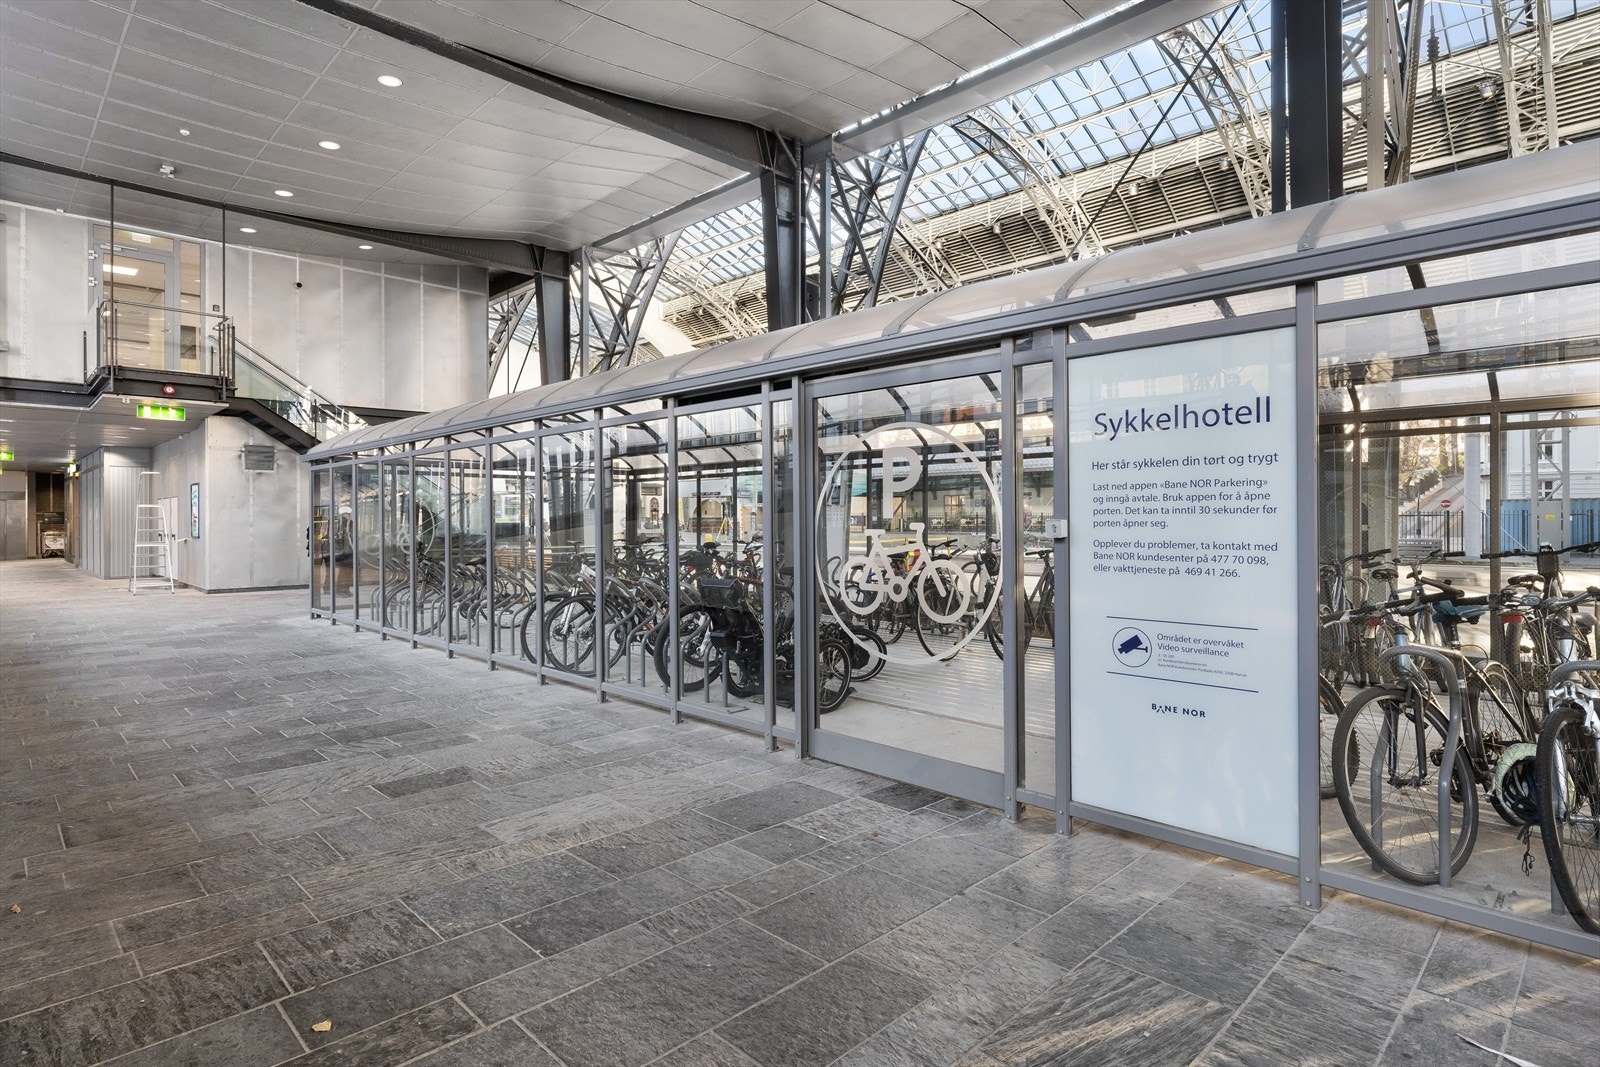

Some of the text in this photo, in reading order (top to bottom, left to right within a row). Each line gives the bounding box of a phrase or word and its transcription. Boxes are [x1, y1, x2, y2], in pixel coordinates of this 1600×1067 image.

[1095, 396, 1270, 441] Sykkelhotell
[1092, 453, 1278, 471] Her står sykkelen din tørt og trygt
[883, 448, 922, 519] P
[1093, 478, 1268, 491] Last ned appen «Bane NOR Parkering»
[1093, 491, 1271, 505] og inngå avtale. Bruk appen for å åpne
[1093, 505, 1278, 517] porten. Det kan ta inntil 30 sekunder før
[1093, 519, 1168, 529] porten åpner seg.
[1093, 540, 1278, 551] Opplever du problemer, ta kontakt med
[1093, 552, 1269, 566] Bane NOR kundesenter på 477 70 098,
[1093, 564, 1241, 578] eller vakttjeneste på 469 41 266.
[1157, 633, 1191, 644] Området
[1203, 638, 1244, 649] overvåket
[1158, 643, 1230, 657] Video surveillance
[1152, 703, 1206, 718] BANE NOR
